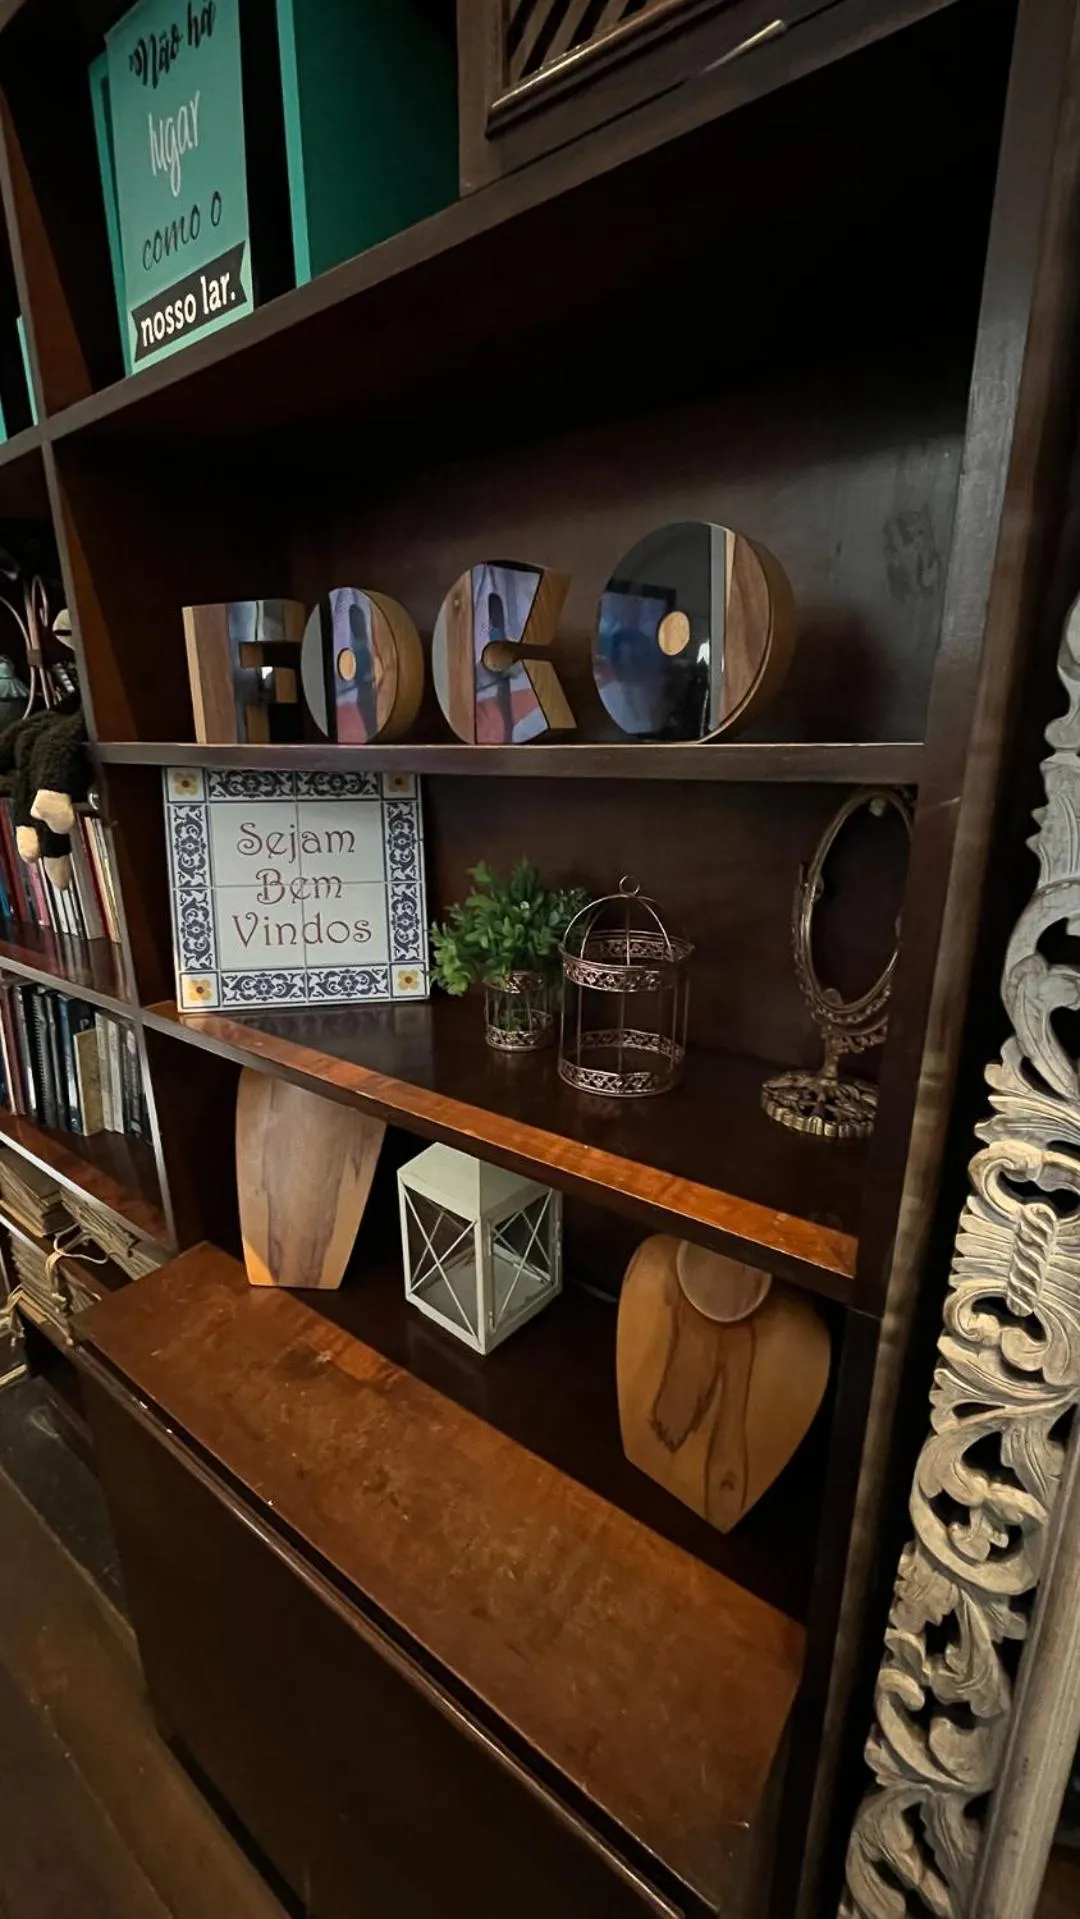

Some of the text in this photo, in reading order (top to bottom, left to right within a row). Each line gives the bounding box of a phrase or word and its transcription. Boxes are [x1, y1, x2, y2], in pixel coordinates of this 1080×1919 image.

[148, 89, 200, 197] lugar
[142, 190, 222, 271] como o
[141, 272, 236, 347] nosso lar.
[236, 822, 355, 864] Sejam
[255, 868, 343, 905] Bem
[232, 911, 372, 949] Vindos
